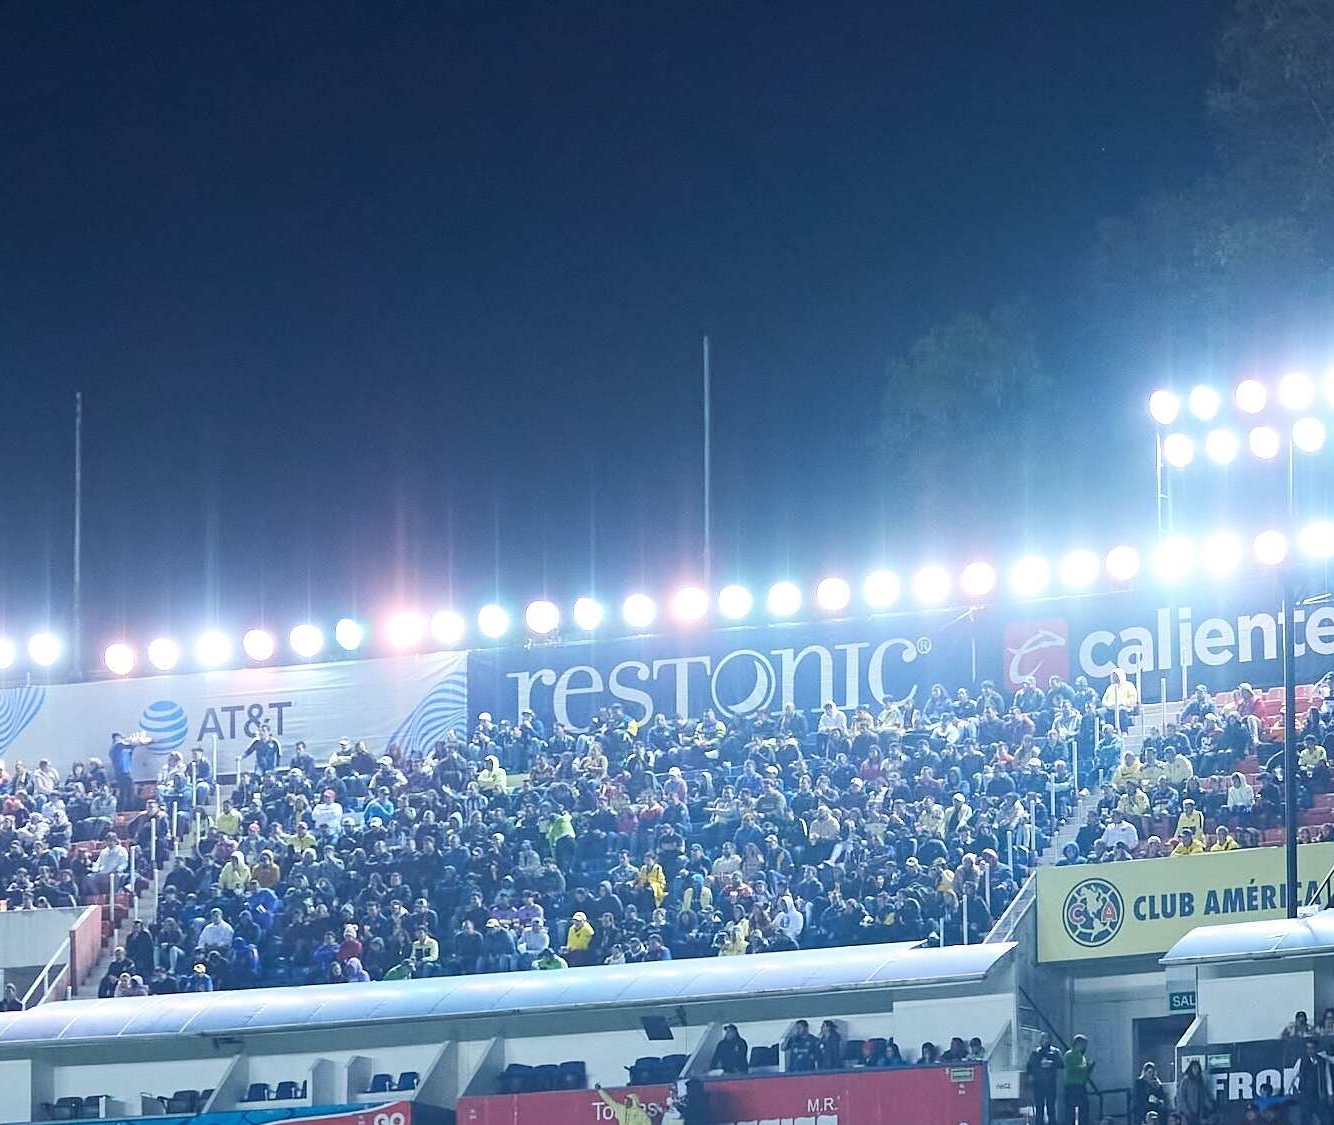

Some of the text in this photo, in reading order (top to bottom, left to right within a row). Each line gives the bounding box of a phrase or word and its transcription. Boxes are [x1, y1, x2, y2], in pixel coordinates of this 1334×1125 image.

[197, 701, 293, 743] AT&T
[1133, 892, 1195, 921] CLUB
[807, 1097, 838, 1113] M.R.
